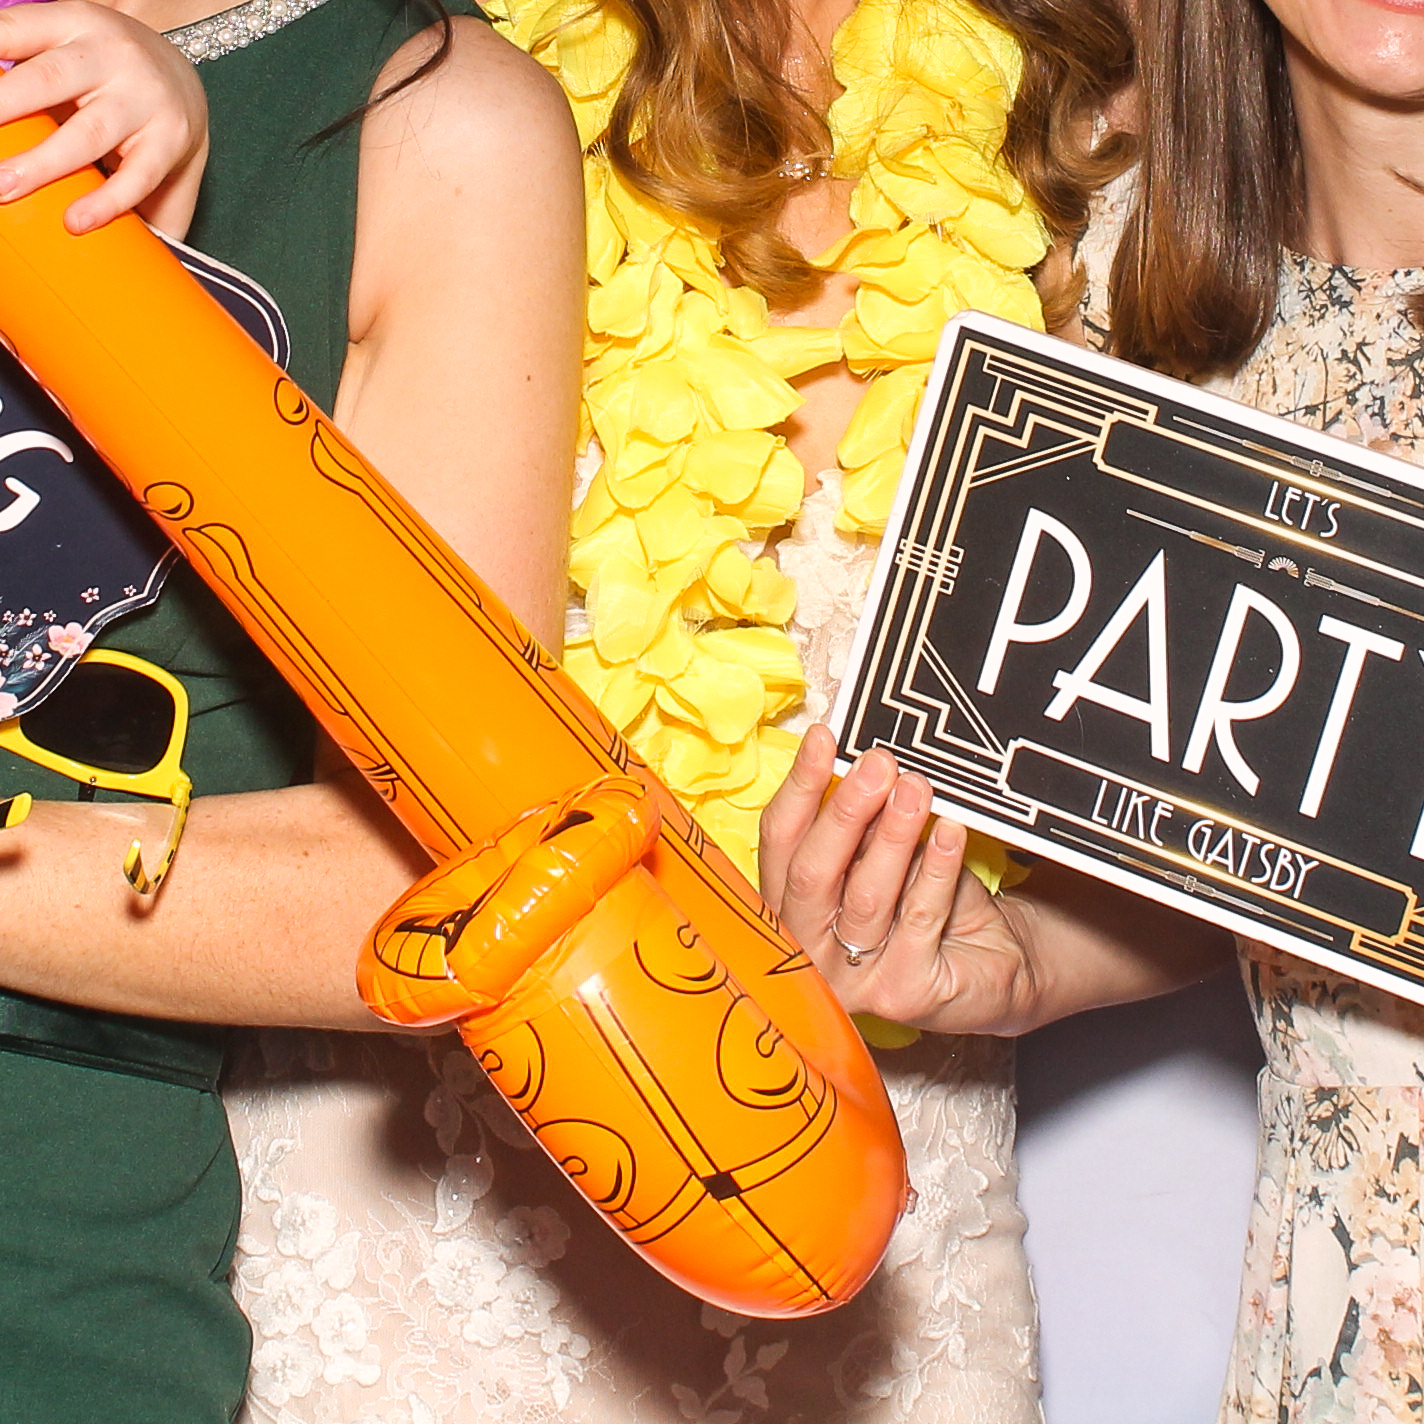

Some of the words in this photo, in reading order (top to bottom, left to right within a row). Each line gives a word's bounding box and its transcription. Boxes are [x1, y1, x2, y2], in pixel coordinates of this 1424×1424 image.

[1263, 479, 1340, 539] LET'S
[1089, 779, 1174, 848] LIKE
[1187, 817, 1320, 899] GATSBY
